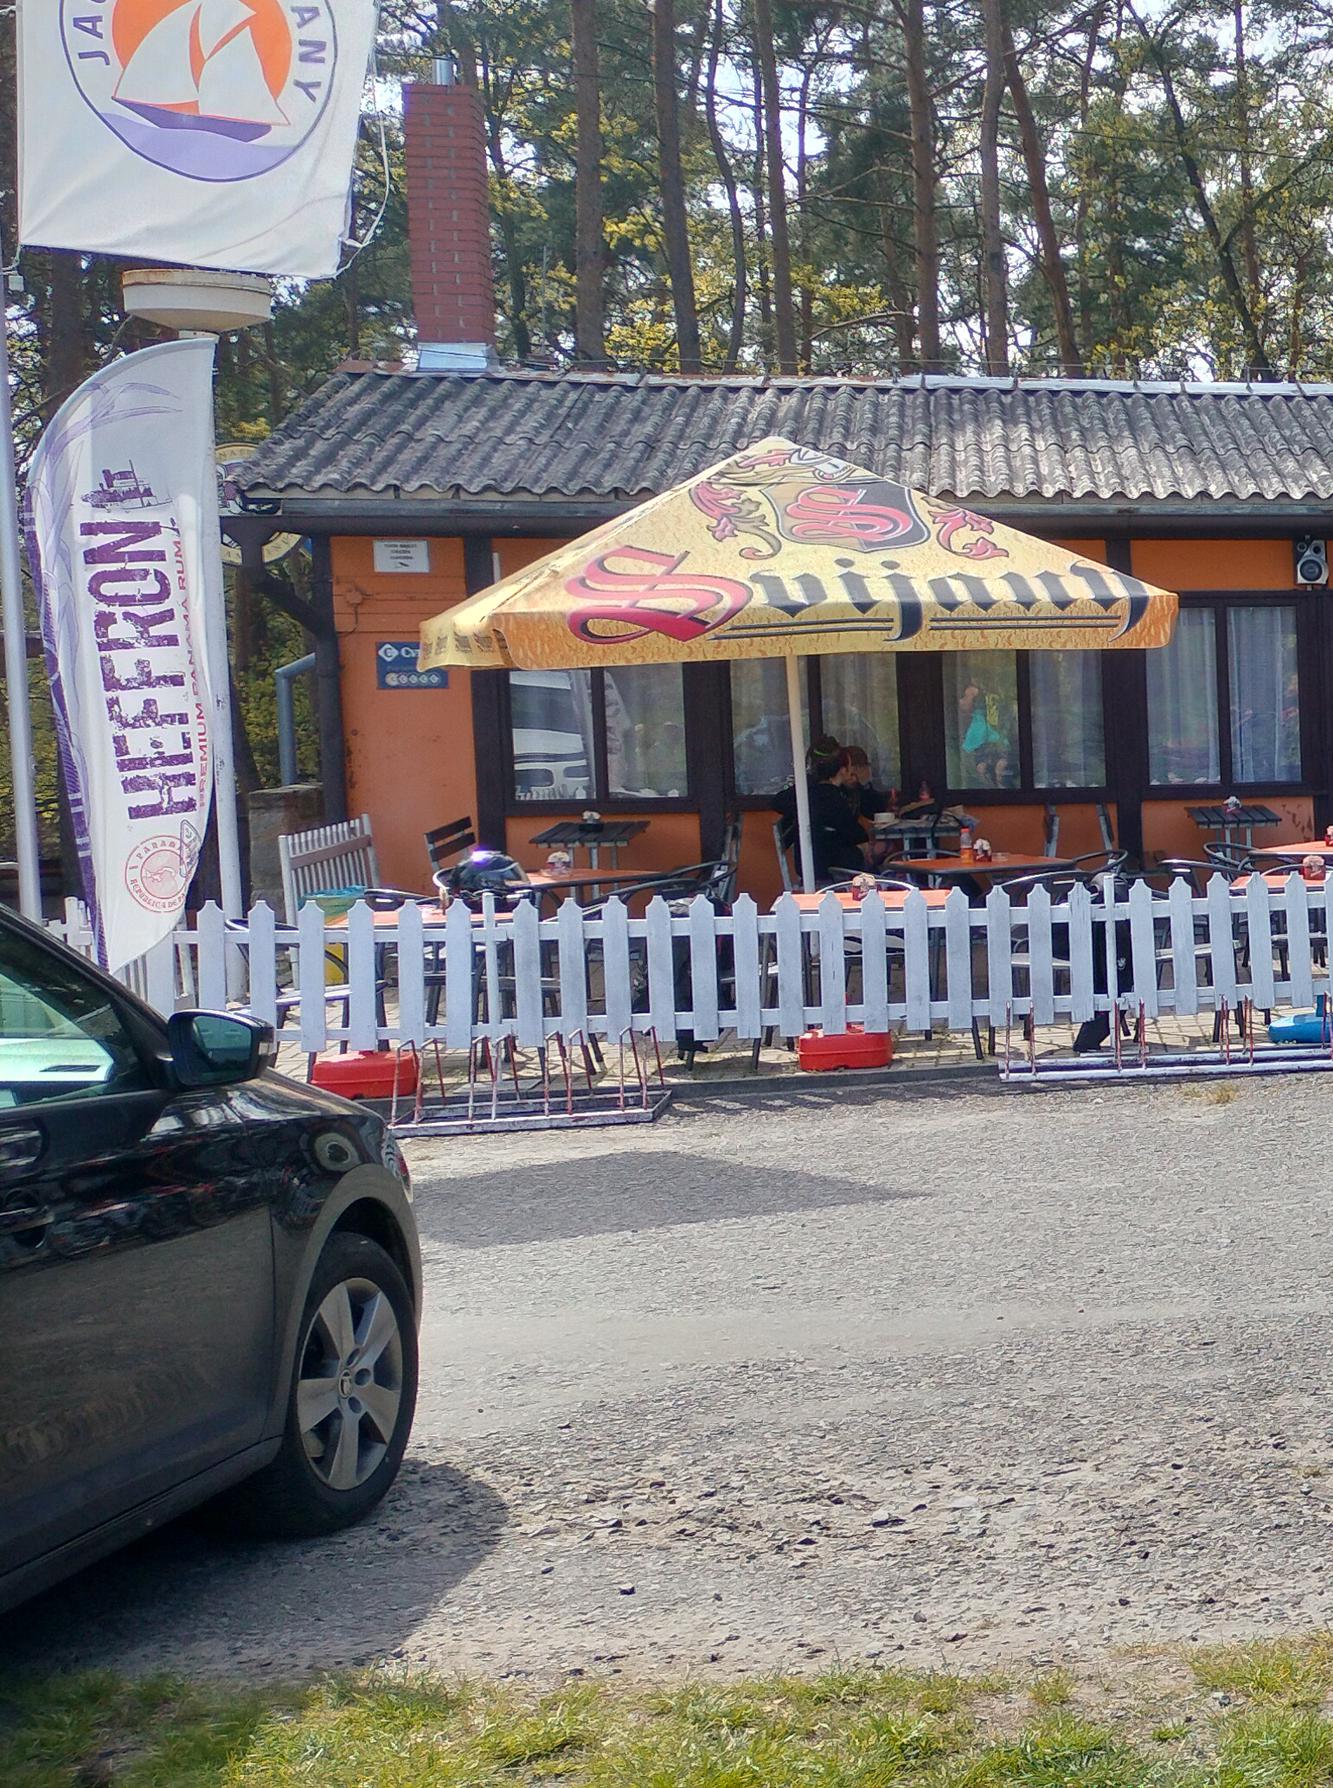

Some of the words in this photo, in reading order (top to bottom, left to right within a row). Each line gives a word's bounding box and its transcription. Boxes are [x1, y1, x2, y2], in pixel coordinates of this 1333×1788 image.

[172, 539, 187, 591] RUM
[564, 543, 1150, 643] Svijany
[79, 520, 198, 820] HEFFRON
[195, 702, 209, 807] PREMIUM
